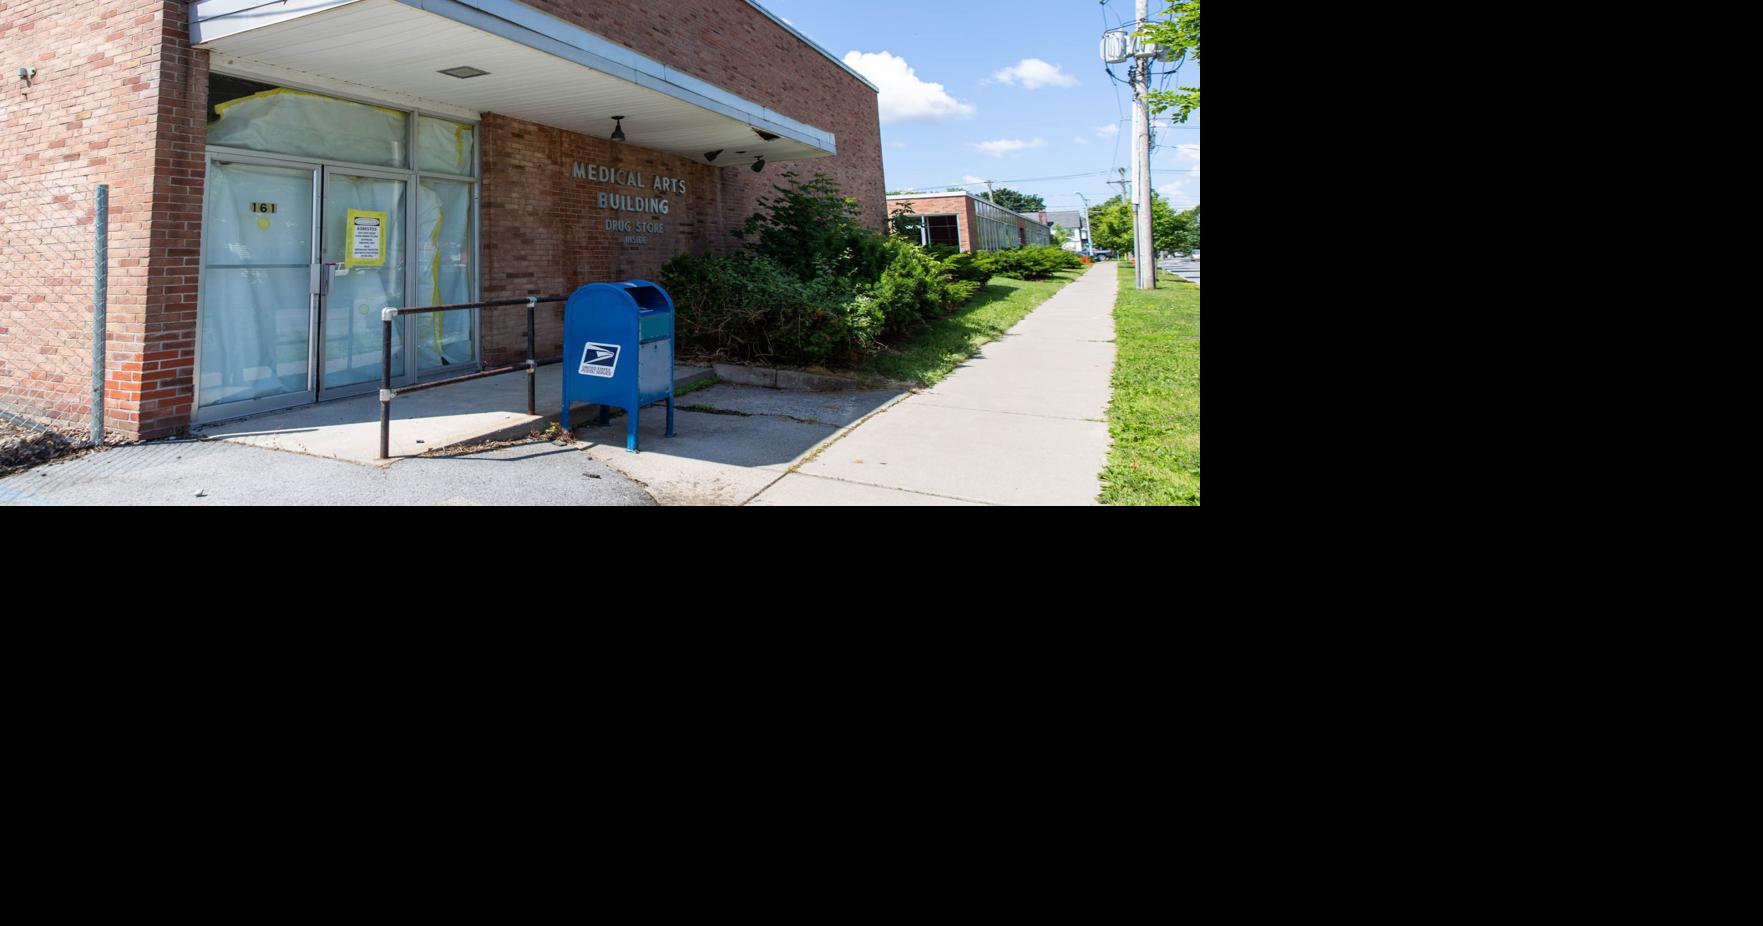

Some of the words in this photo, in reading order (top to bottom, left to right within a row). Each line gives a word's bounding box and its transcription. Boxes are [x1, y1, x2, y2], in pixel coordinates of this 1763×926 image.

[572, 161, 645, 188] MEDICAL
[653, 175, 686, 194] ARTS
[252, 202, 275, 214] 161
[598, 191, 669, 214] BUILDING
[605, 218, 632, 232] DRUG
[635, 221, 664, 233] STORE
